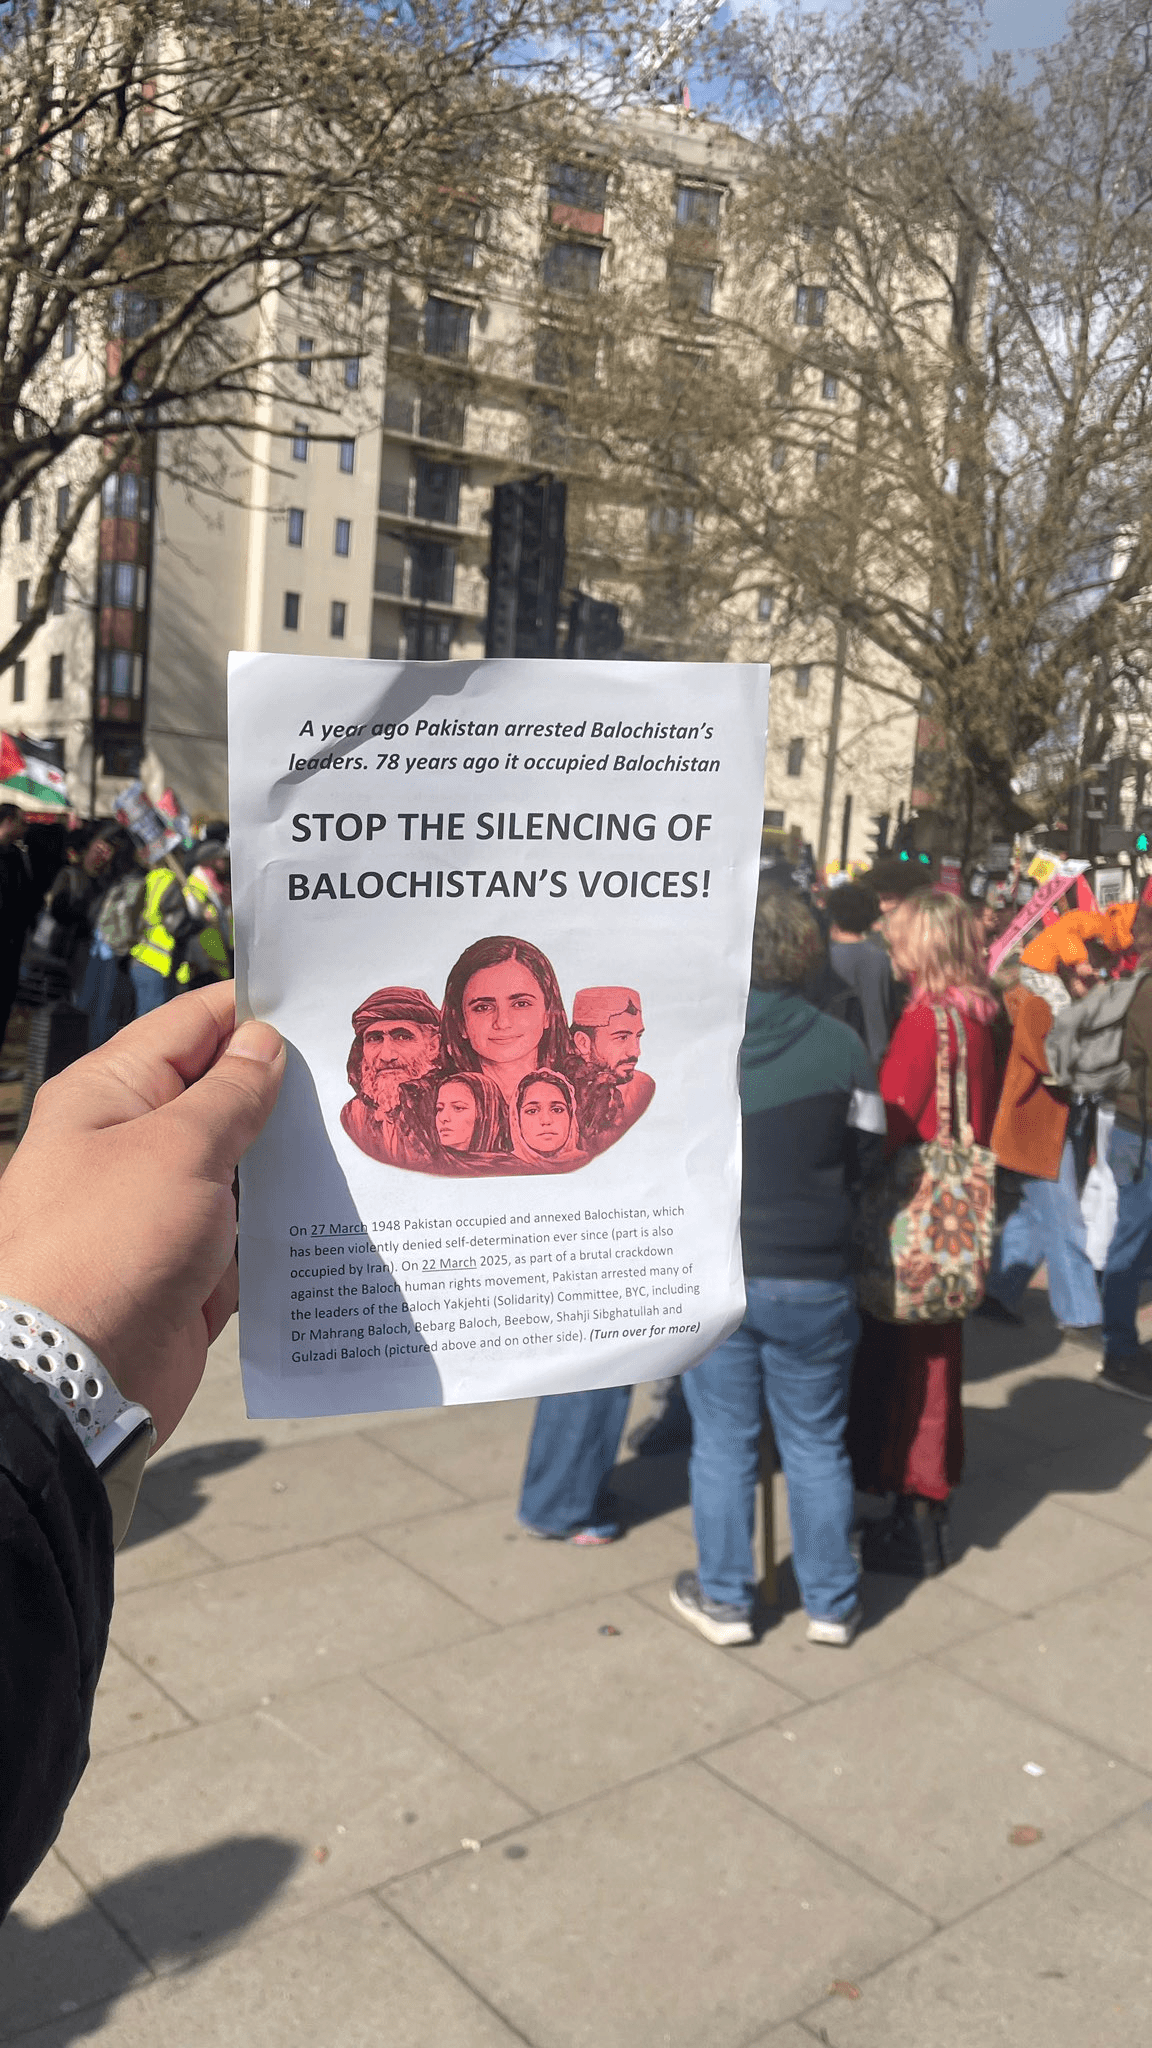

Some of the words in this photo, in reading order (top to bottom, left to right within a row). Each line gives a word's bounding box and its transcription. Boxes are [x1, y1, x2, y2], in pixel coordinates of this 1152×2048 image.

[299, 720, 315, 737] A
[321, 723, 366, 741] year
[371, 721, 409, 740] ago
[415, 720, 499, 737] Pakistan
[504, 721, 586, 738] arrested
[289, 754, 369, 771] leaders.
[376, 754, 400, 770] 78
[404, 757, 457, 774] years
[462, 757, 500, 774] ago
[504, 754, 519, 770] it
[524, 755, 608, 775] occupied
[613, 755, 720, 772] Balochistan
[292, 814, 387, 842] STOP
[398, 814, 464, 841] THE
[476, 813, 656, 841] SILENCING
[667, 814, 713, 841] OF
[579, 871, 710, 898] VOICES!
[290, 1226, 307, 1236] On
[311, 1224, 325, 1237] 27
[330, 1223, 368, 1236] March
[372, 1221, 400, 1231] 1948
[404, 1218, 451, 1230] Pakistan
[456, 1214, 506, 1228] occupied
[510, 1213, 530, 1224] and
[534, 1211, 581, 1223] annexed
[584, 1208, 650, 1220] Balochistan,
[653, 1206, 684, 1216] which
[290, 1246, 310, 1257] has
[315, 1245, 344, 1255] been
[348, 1241, 399, 1255] violently
[403, 1238, 442, 1250] denied
[445, 1233, 550, 1248] self-determination
[553, 1232, 577, 1241] ever
[581, 1231, 608, 1240] since
[612, 1228, 638, 1241] (part
[641, 1227, 649, 1237] is
[652, 1226, 673, 1237] also
[290, 1264, 345, 1279] occupied
[349, 1262, 363, 1275] by
[367, 1261, 398, 1274] Iran).
[402, 1261, 418, 1271] On
[422, 1259, 436, 1272] 22
[440, 1257, 477, 1270] March
[481, 1255, 511, 1267] 2025,
[515, 1255, 526, 1264] as
[530, 1253, 552, 1265] part
[555, 1252, 569, 1262] of
[580, 1249, 611, 1260] brutal
[615, 1246, 673, 1258] crackdown
[291, 1286, 334, 1301] against
[338, 1285, 358, 1296] the
[362, 1283, 400, 1295] Baloch
[405, 1280, 445, 1291] human
[449, 1278, 481, 1291] rights
[485, 1275, 549, 1286] movement,
[553, 1270, 598, 1282] Pakistan
[601, 1266, 647, 1279] arrested
[650, 1265, 679, 1278] many
[682, 1263, 693, 1274] of
[291, 1309, 311, 1320] the
[315, 1306, 359, 1318] leaders
[363, 1304, 376, 1315] of
[378, 1303, 398, 1314] the
[402, 1300, 441, 1312] Baloch
[444, 1297, 490, 1310] Yakjehti
[494, 1291, 554, 1308] (Solidarity)
[558, 1289, 622, 1302] Committee,
[626, 1286, 649, 1298] BYC,
[652, 1283, 700, 1295] including
[292, 1331, 306, 1341] Dr
[310, 1327, 364, 1340] Mahrang
[368, 1324, 411, 1336] Baloch,
[415, 1321, 455, 1332] Bebarg
[459, 1316, 500, 1330] Baloch,
[505, 1314, 553, 1326] Beebow,
[557, 1310, 590, 1322] Shahji
[593, 1306, 659, 1321] Sibghatullah
[663, 1304, 682, 1315] and
[292, 1350, 337, 1363] Gulzadi
[341, 1346, 380, 1359] Baloch
[385, 1343, 438, 1358] (pictured
[442, 1339, 476, 1351] above
[480, 1336, 500, 1348] and
[505, 1338, 519, 1346] on
[523, 1334, 552, 1345] other
[557, 1330, 587, 1343] side).
[590, 1329, 619, 1342] (Turn
[623, 1329, 647, 1337] over
[649, 1326, 665, 1337] for
[669, 1322, 700, 1335] more)
